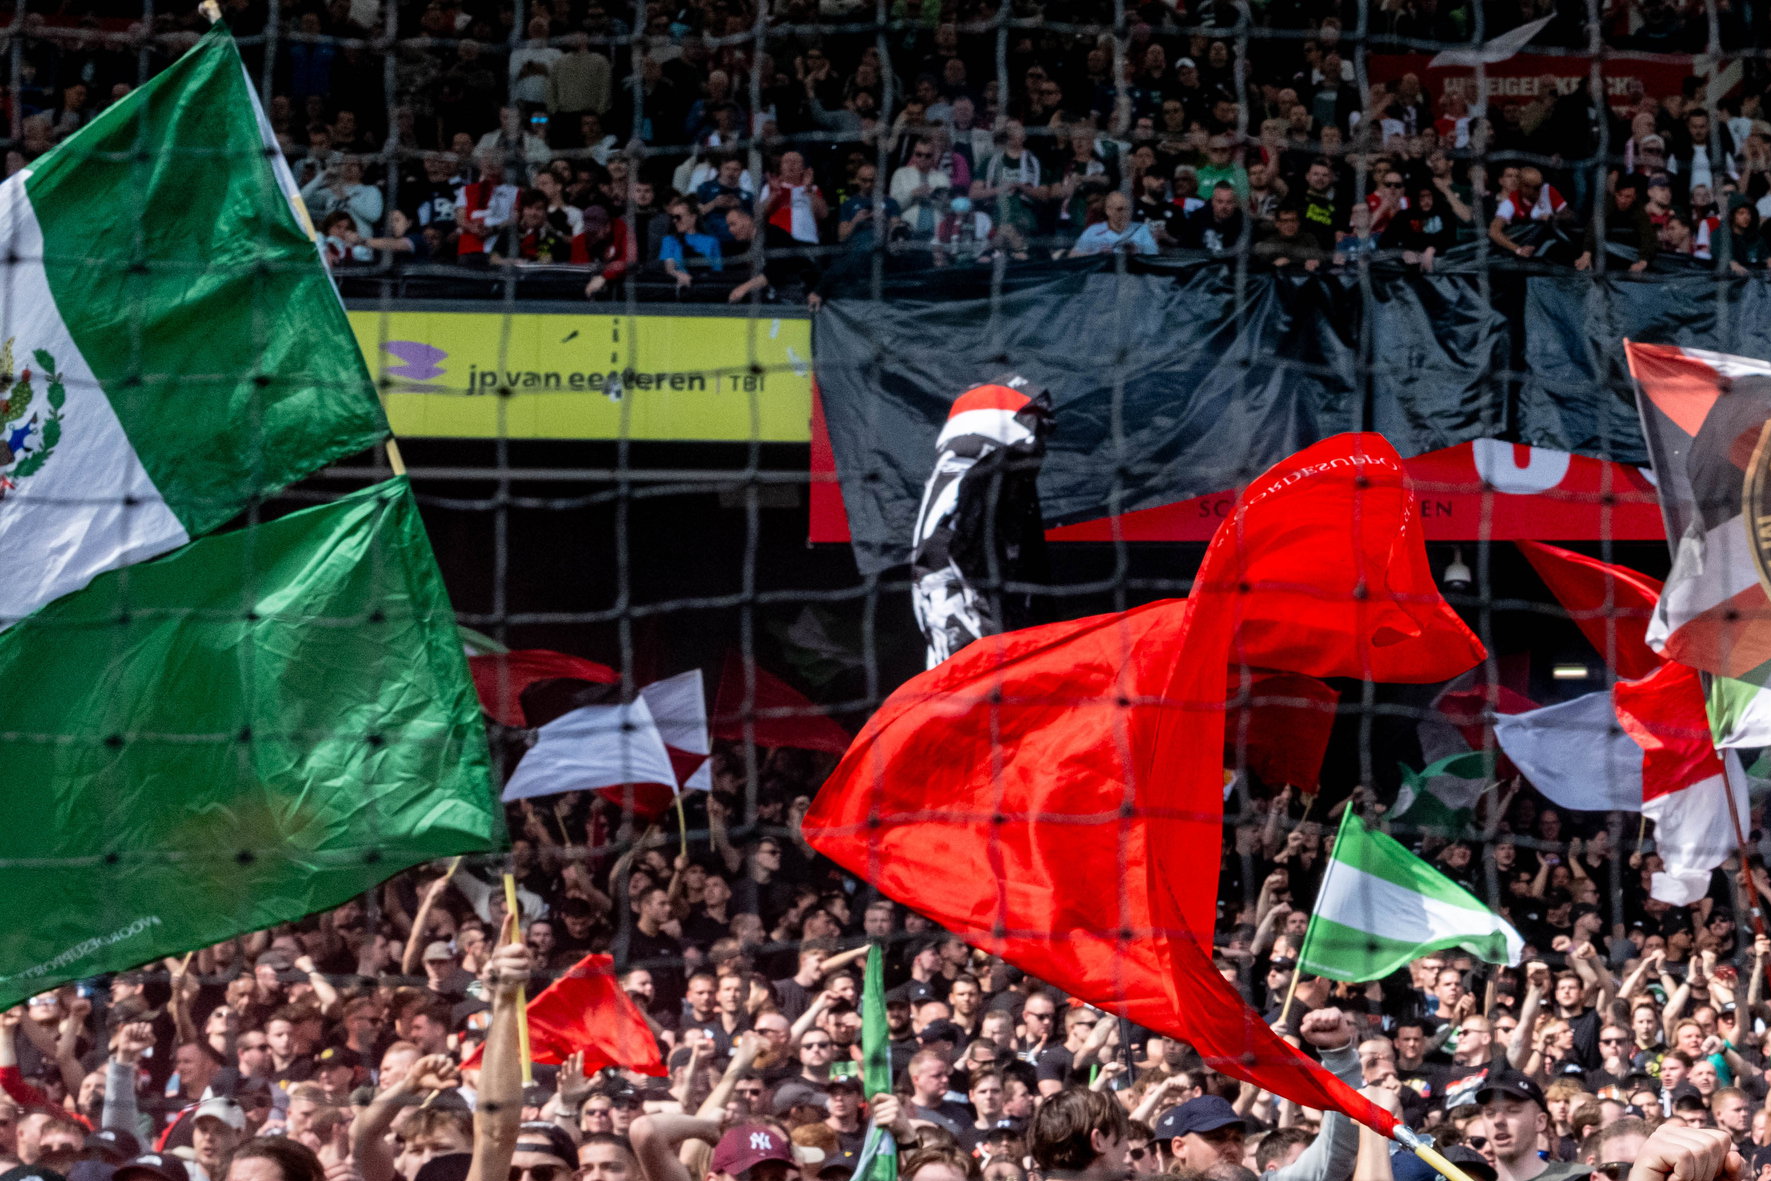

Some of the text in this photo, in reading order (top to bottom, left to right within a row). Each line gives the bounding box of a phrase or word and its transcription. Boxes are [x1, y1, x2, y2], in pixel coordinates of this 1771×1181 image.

[466, 365, 498, 396] jp
[506, 371, 562, 388] van
[728, 374, 766, 392] TBI
